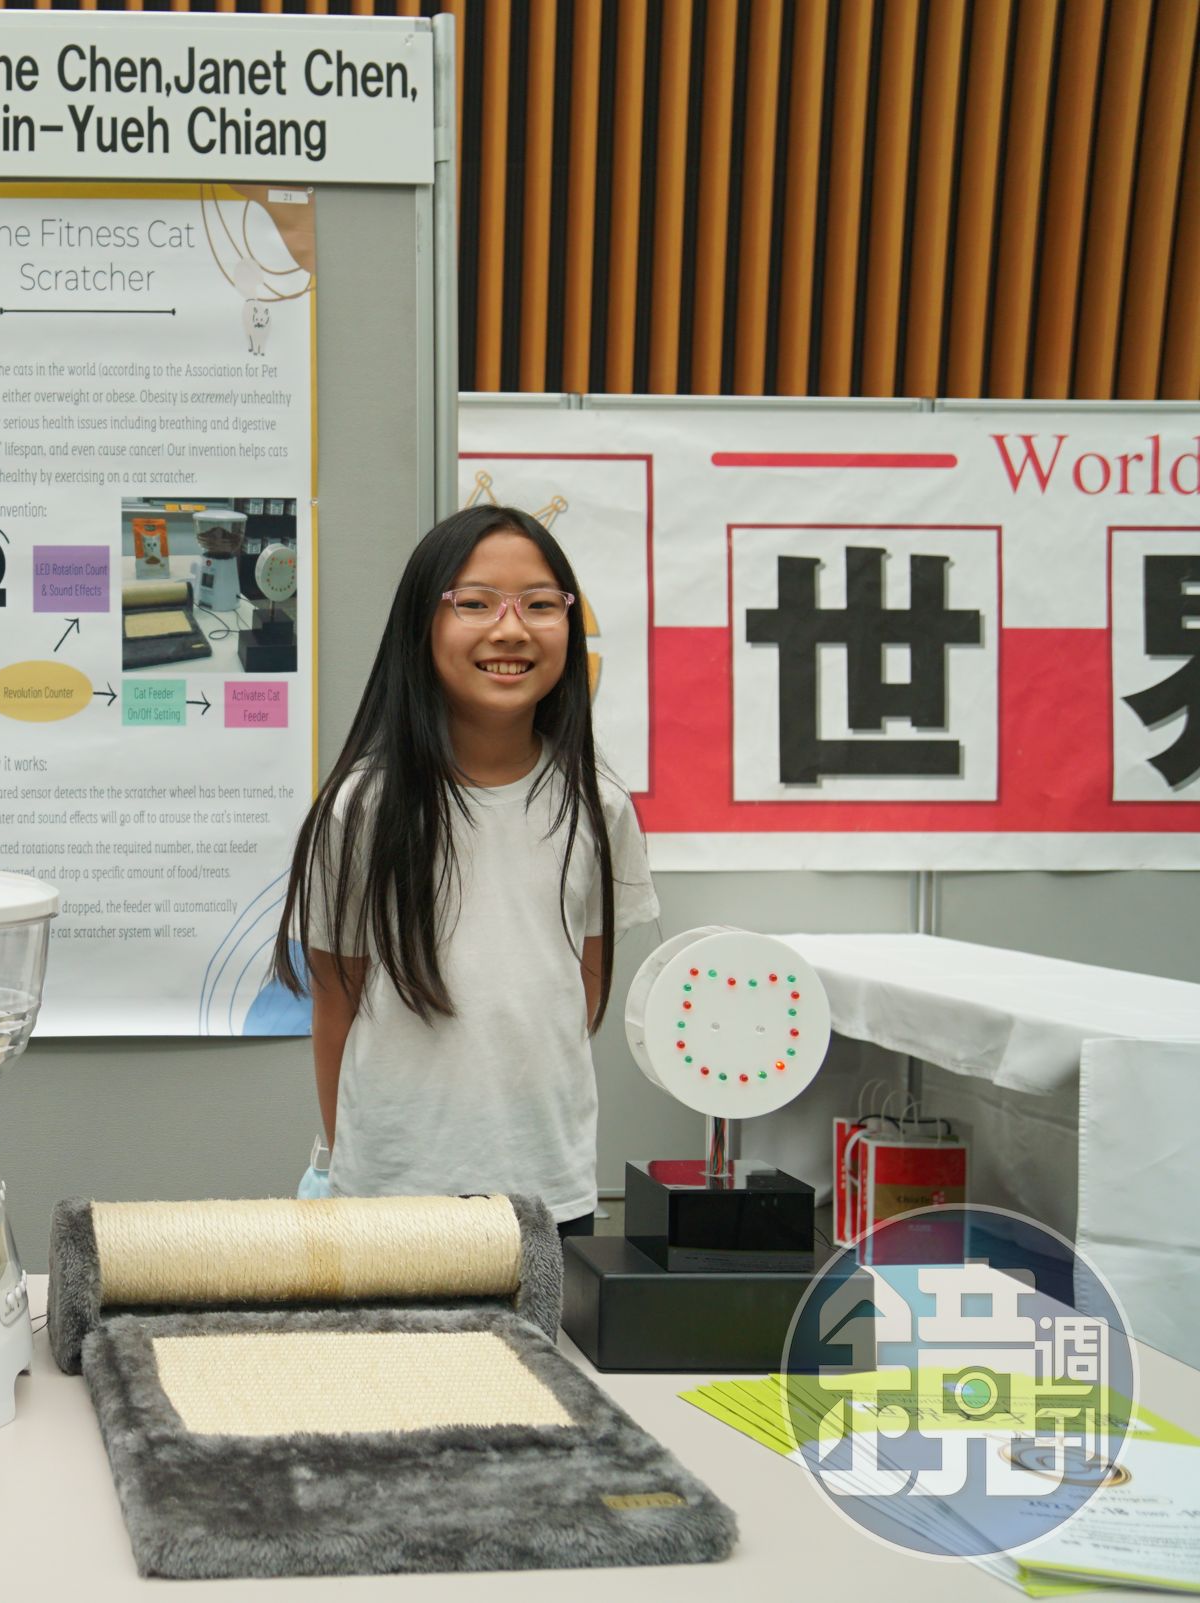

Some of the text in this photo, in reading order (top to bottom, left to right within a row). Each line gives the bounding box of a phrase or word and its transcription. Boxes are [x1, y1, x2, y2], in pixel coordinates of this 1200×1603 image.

[57, 45, 286, 97] Chen,Janet
[304, 48, 417, 101] Chen,
[187, 107, 326, 160] Chiang
[41, 218, 139, 248] Fitness
[147, 219, 195, 248] Cat
[20, 261, 155, 291] Scratcher
[12, 364, 33, 376] cats
[35, 362, 45, 376] in
[48, 361, 65, 376] the
[66, 362, 96, 376] world
[98, 362, 151, 379] (according
[152, 365, 163, 376] to
[165, 362, 182, 376] the
[184, 363, 243, 377] Association
[244, 362, 258, 377] for
[261, 363, 277, 378] Pet
[989, 433, 1200, 495] World
[39, 468, 52, 486] by
[54, 471, 104, 486] exercising
[106, 472, 120, 483] on
[122, 472, 129, 483] a
[131, 471, 147, 483] cat
[149, 468, 197, 483] scratcher.
[36, 563, 108, 576] LED Rotation Count
[50, 584, 72, 597] Sound
[74, 584, 102, 597] Effects
[4, 686, 74, 700] Revolution Counter
[134, 687, 174, 700] Cat Feeder
[232, 688, 280, 702] Activates Cat
[154, 707, 181, 723] Setting
[243, 708, 269, 722] Feeder
[4, 755, 11, 771] it
[14, 755, 47, 771] works:
[21, 788, 51, 799] sensor
[54, 785, 88, 799] detects
[90, 785, 106, 799] the
[106, 785, 122, 799] the
[124, 785, 167, 799] scratcher
[168, 784, 198, 798] wheel
[200, 785, 216, 798] has
[217, 784, 240, 798] been
[278, 784, 294, 798] the
